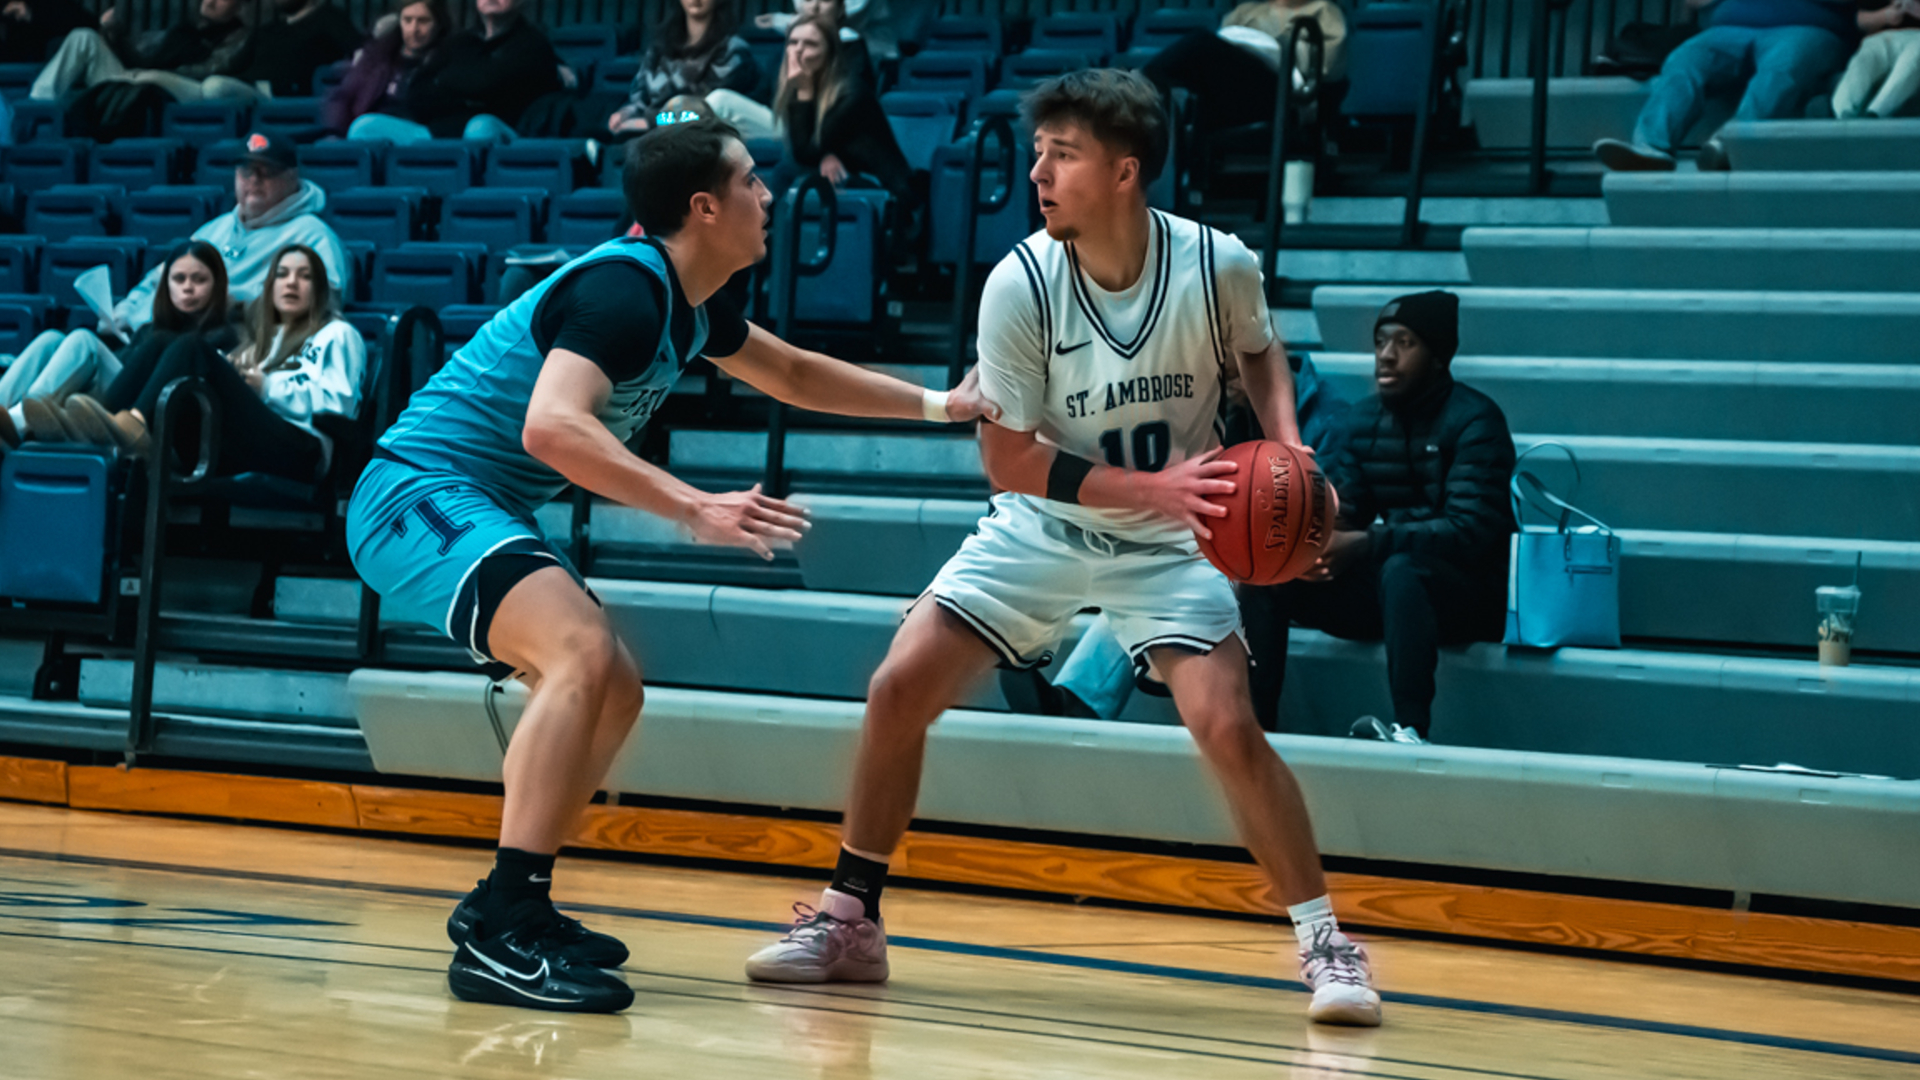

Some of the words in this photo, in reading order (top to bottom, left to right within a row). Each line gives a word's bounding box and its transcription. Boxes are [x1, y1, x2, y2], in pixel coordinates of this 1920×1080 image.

[1066, 389, 1096, 418] ST.
[1104, 373, 1194, 412] AMBROSE
[1099, 420, 1171, 474] 10
[1264, 456, 1292, 552] SPALDING
